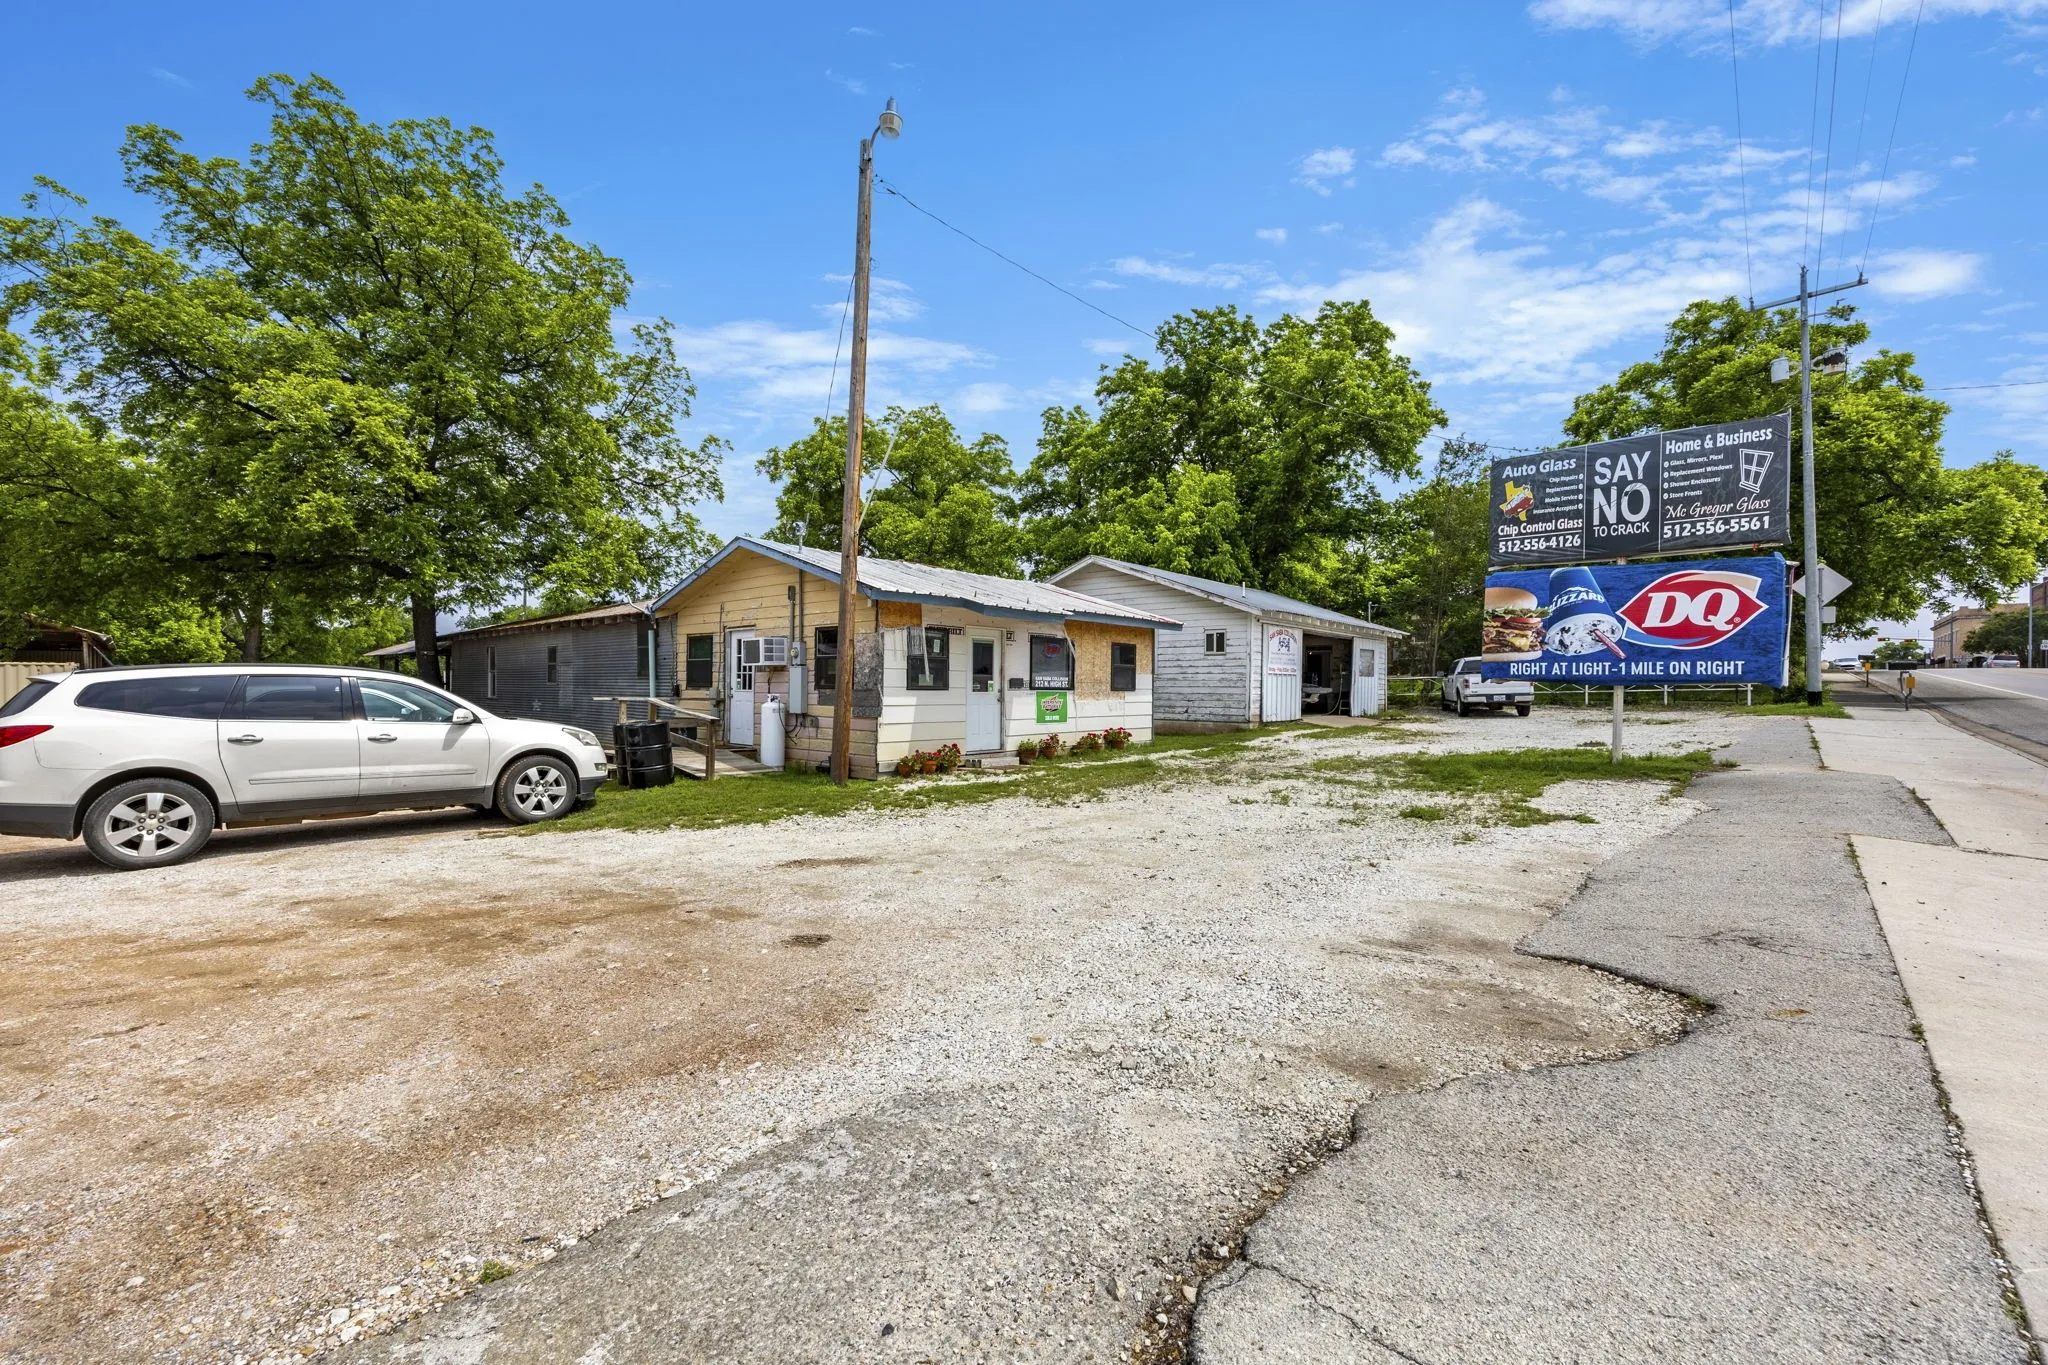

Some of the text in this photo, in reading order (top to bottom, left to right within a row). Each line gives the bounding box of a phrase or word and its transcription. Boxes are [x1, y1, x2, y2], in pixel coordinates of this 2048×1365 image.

[1666, 428, 1772, 454] Home & Business
[1502, 459, 1576, 478] Auto Glass
[1594, 451, 1651, 485] SAY
[1670, 468, 1705, 477] Replacement
[1546, 485, 1577, 493] Replacements
[1593, 483, 1650, 525] NO
[1665, 494, 1770, 521] Mc Gregor Glass
[1498, 519, 1582, 537] Chip Control Glass
[1593, 522, 1650, 537] TO CRACK
[1664, 516, 1770, 538] 512-556-5561
[1499, 534, 1581, 553] 512-556-4126
[1548, 592, 1605, 611] LIZZARD
[1642, 588, 1740, 631] DQ
[1510, 661, 1744, 675] RIGHT AT LIGHT-1 MILE ON RIGHT
